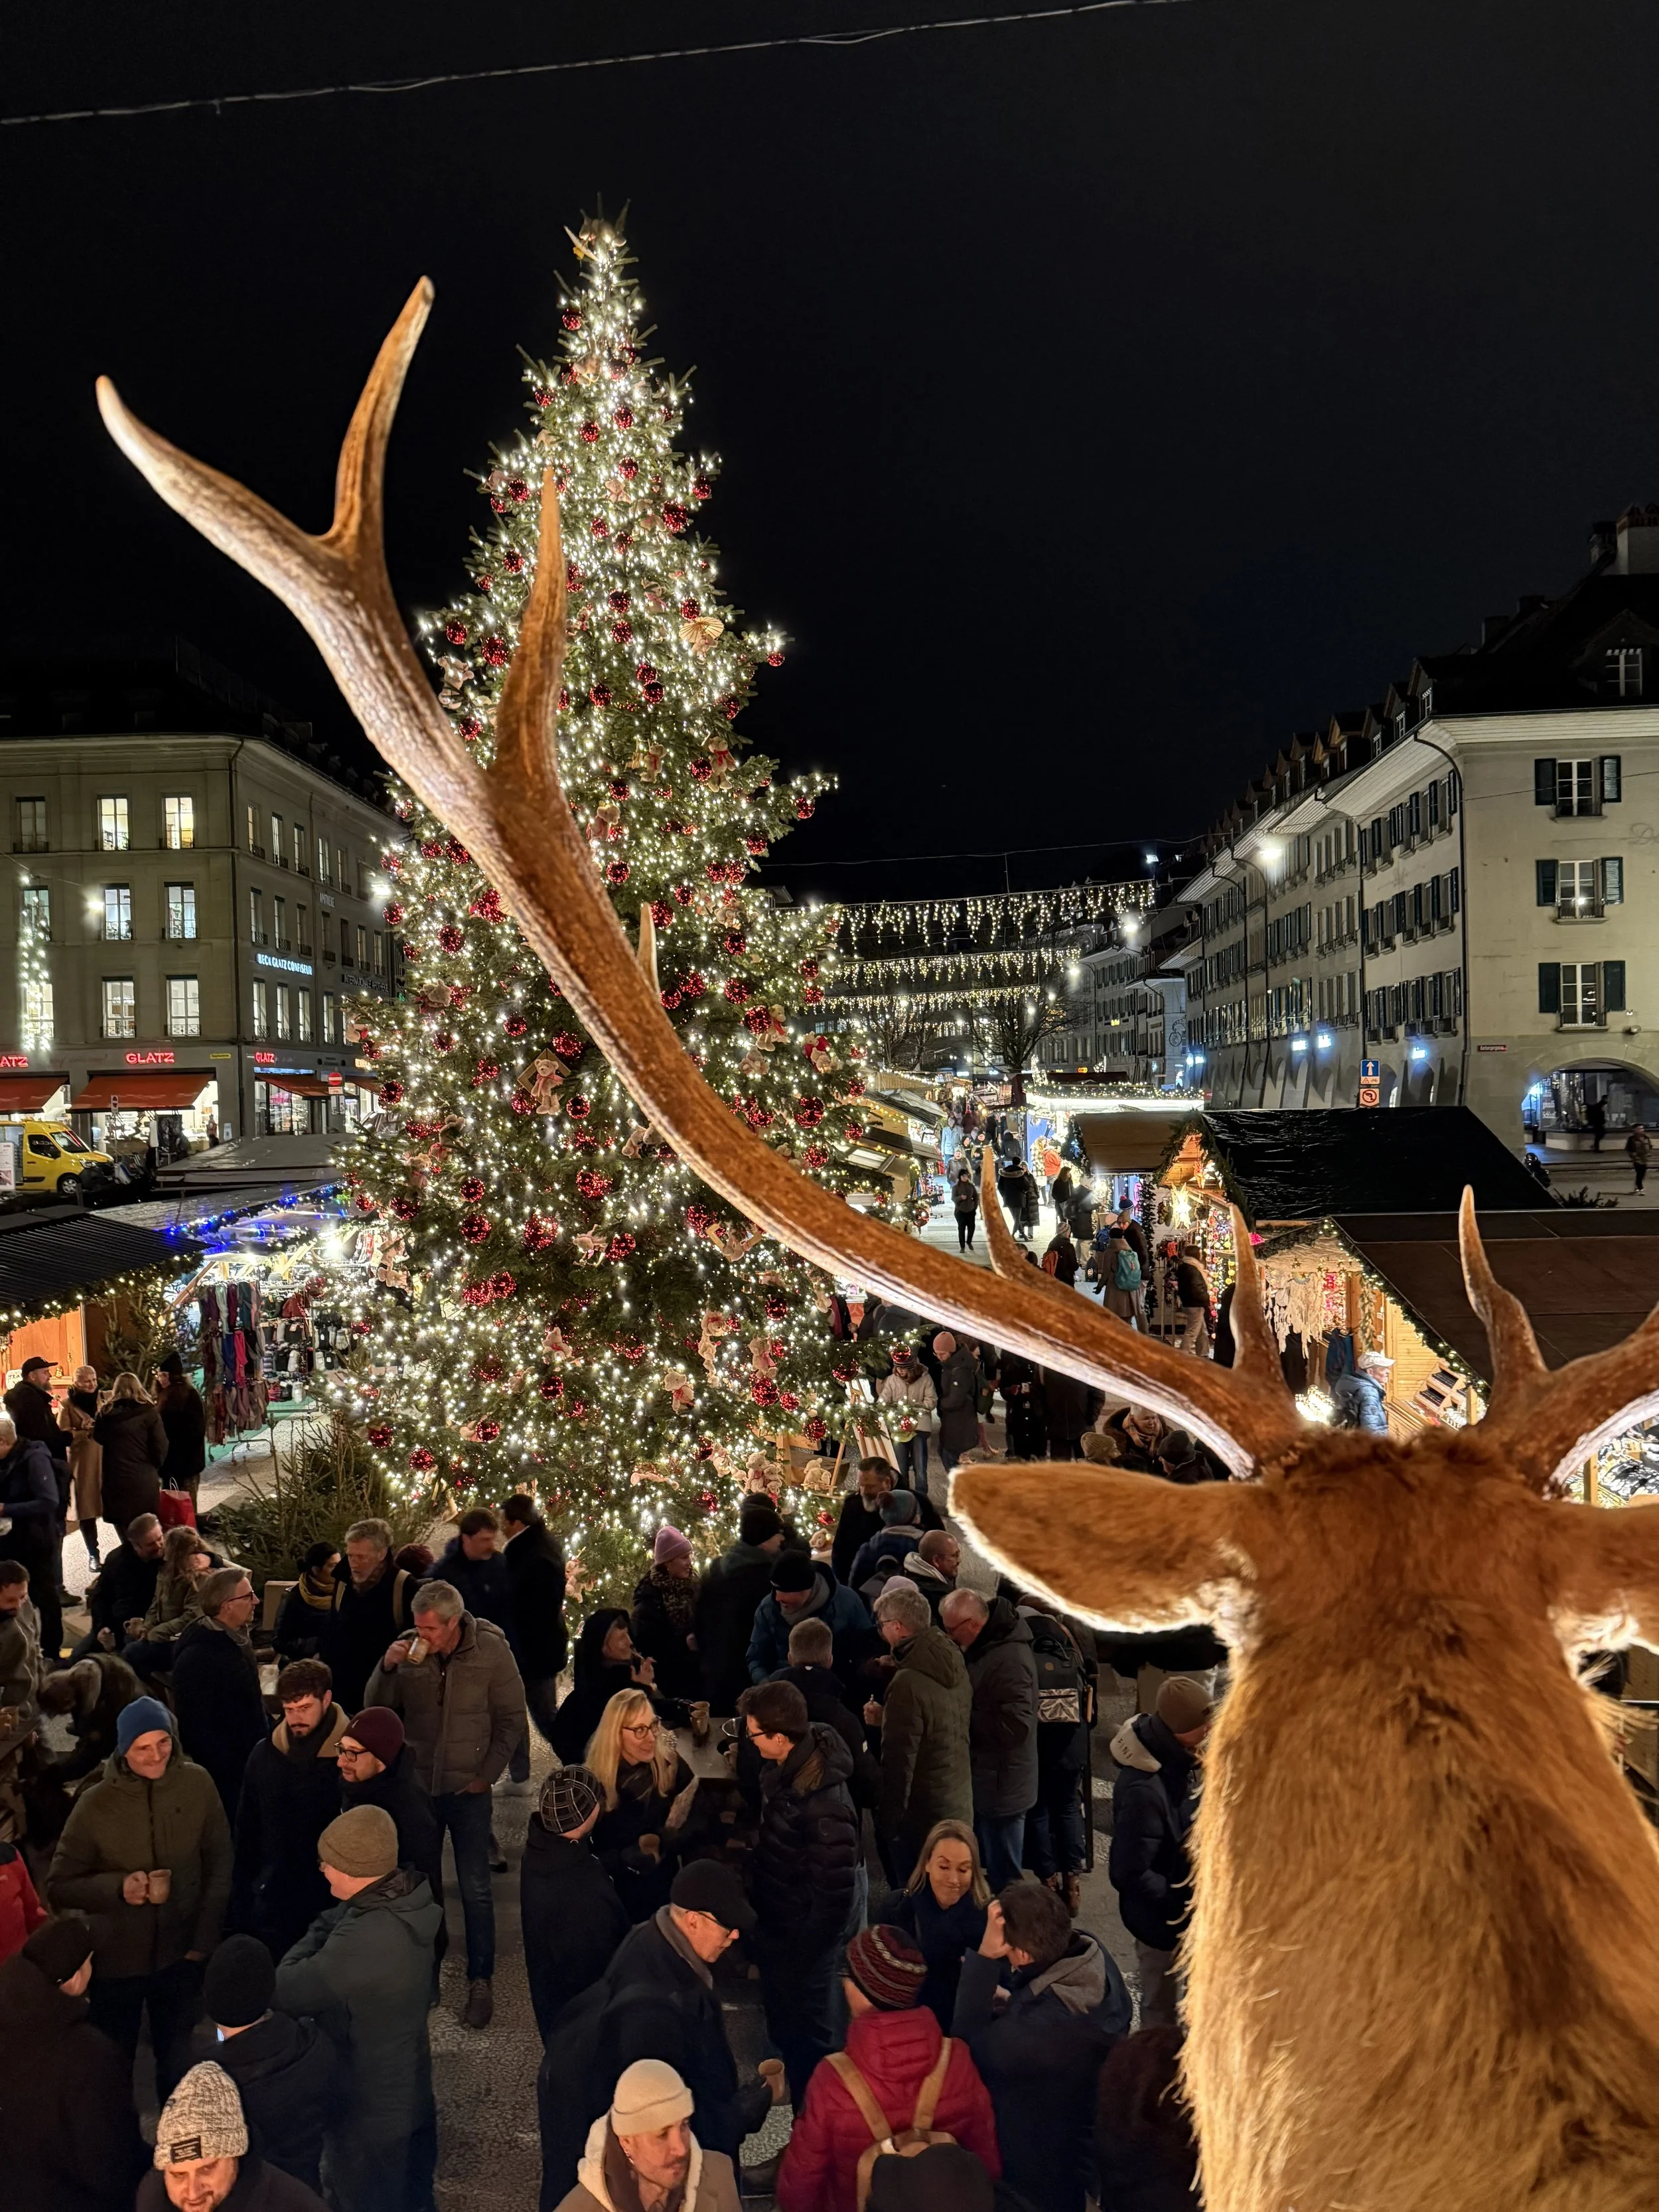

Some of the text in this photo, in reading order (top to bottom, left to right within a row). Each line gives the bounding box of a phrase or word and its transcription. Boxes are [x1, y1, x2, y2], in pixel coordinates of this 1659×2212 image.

[257, 953, 313, 976] BECK GLATZ CONFISEUR
[125, 1052, 175, 1064] GLATZ
[255, 1052, 275, 1063] GLATZ
